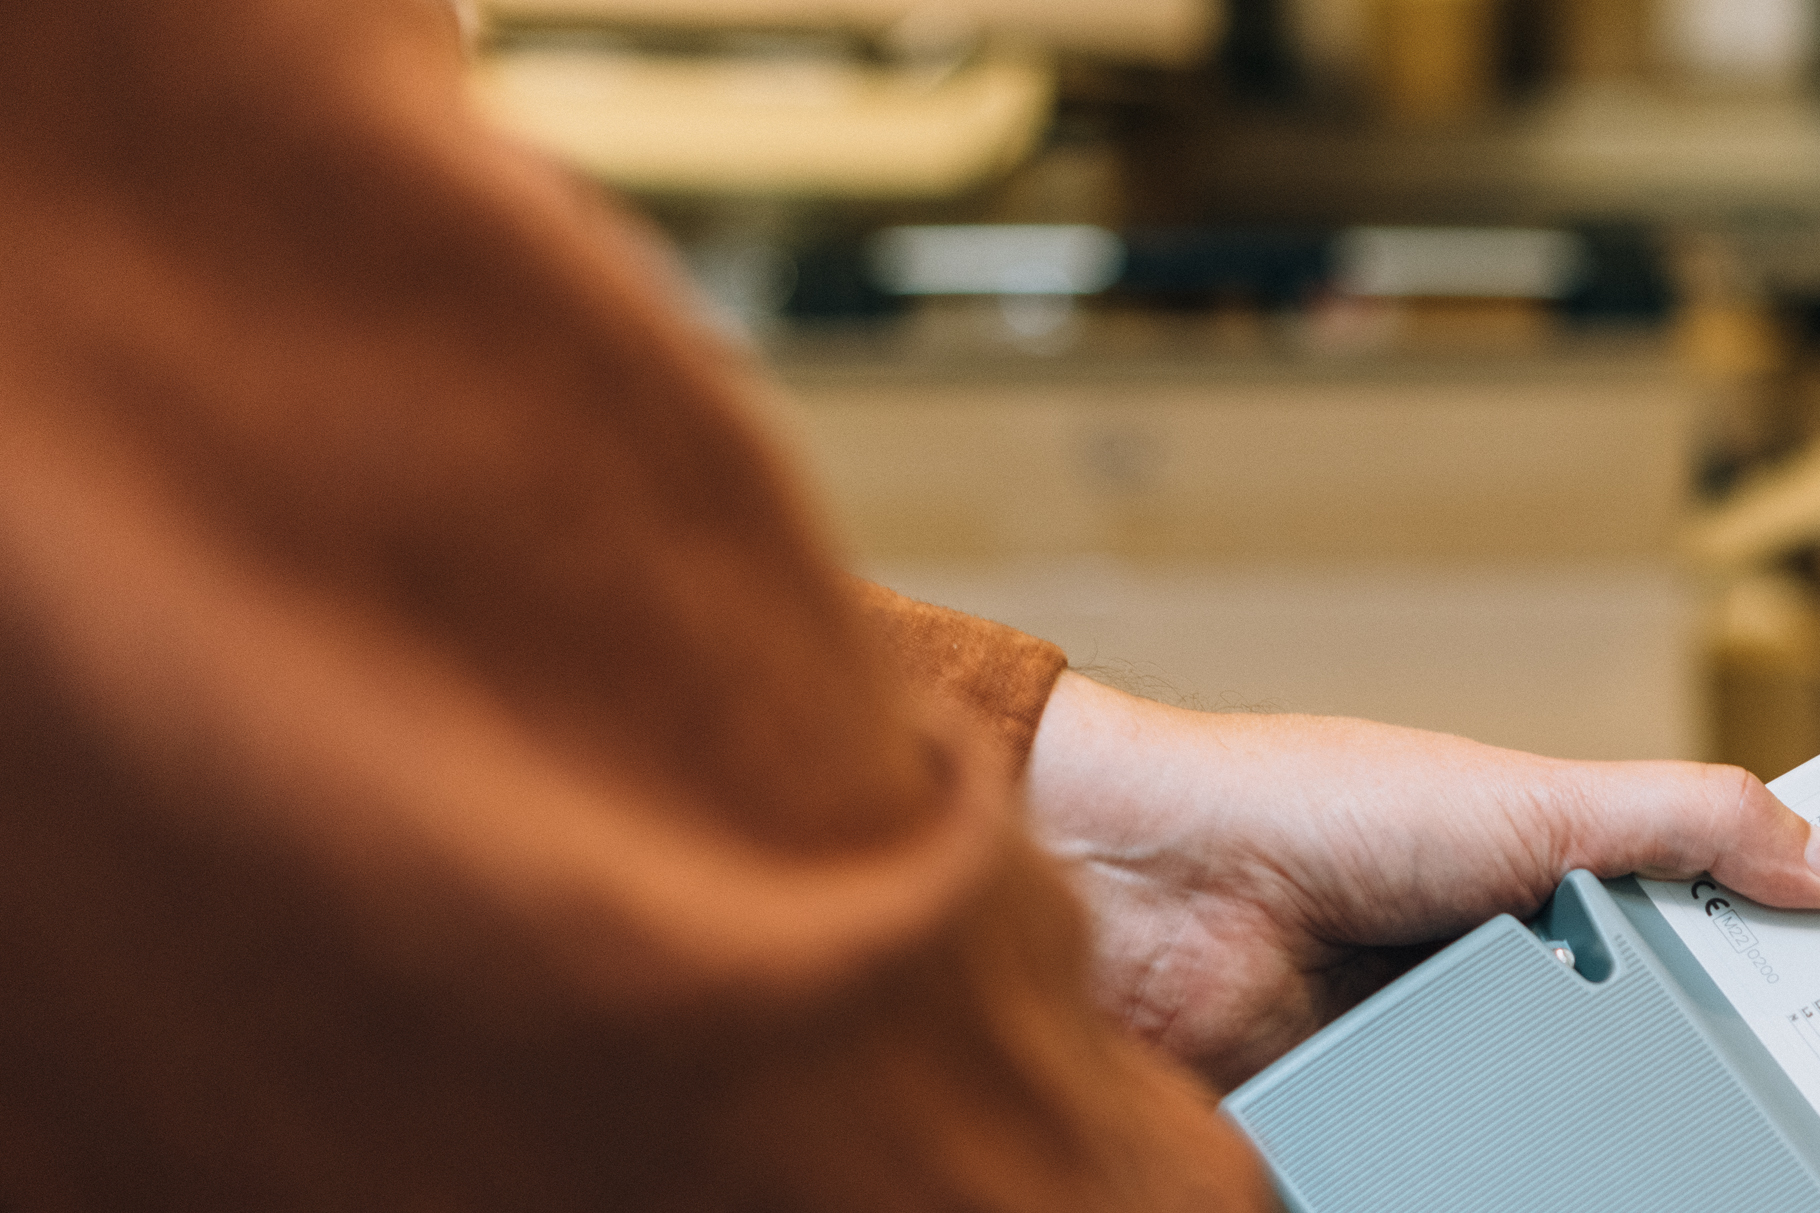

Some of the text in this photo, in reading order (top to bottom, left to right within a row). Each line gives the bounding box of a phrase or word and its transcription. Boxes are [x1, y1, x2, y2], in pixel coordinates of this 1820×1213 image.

[1719, 915, 1750, 946] M22
[1746, 948, 1780, 984] 0200
[1801, 1008, 1813, 1017] L3
